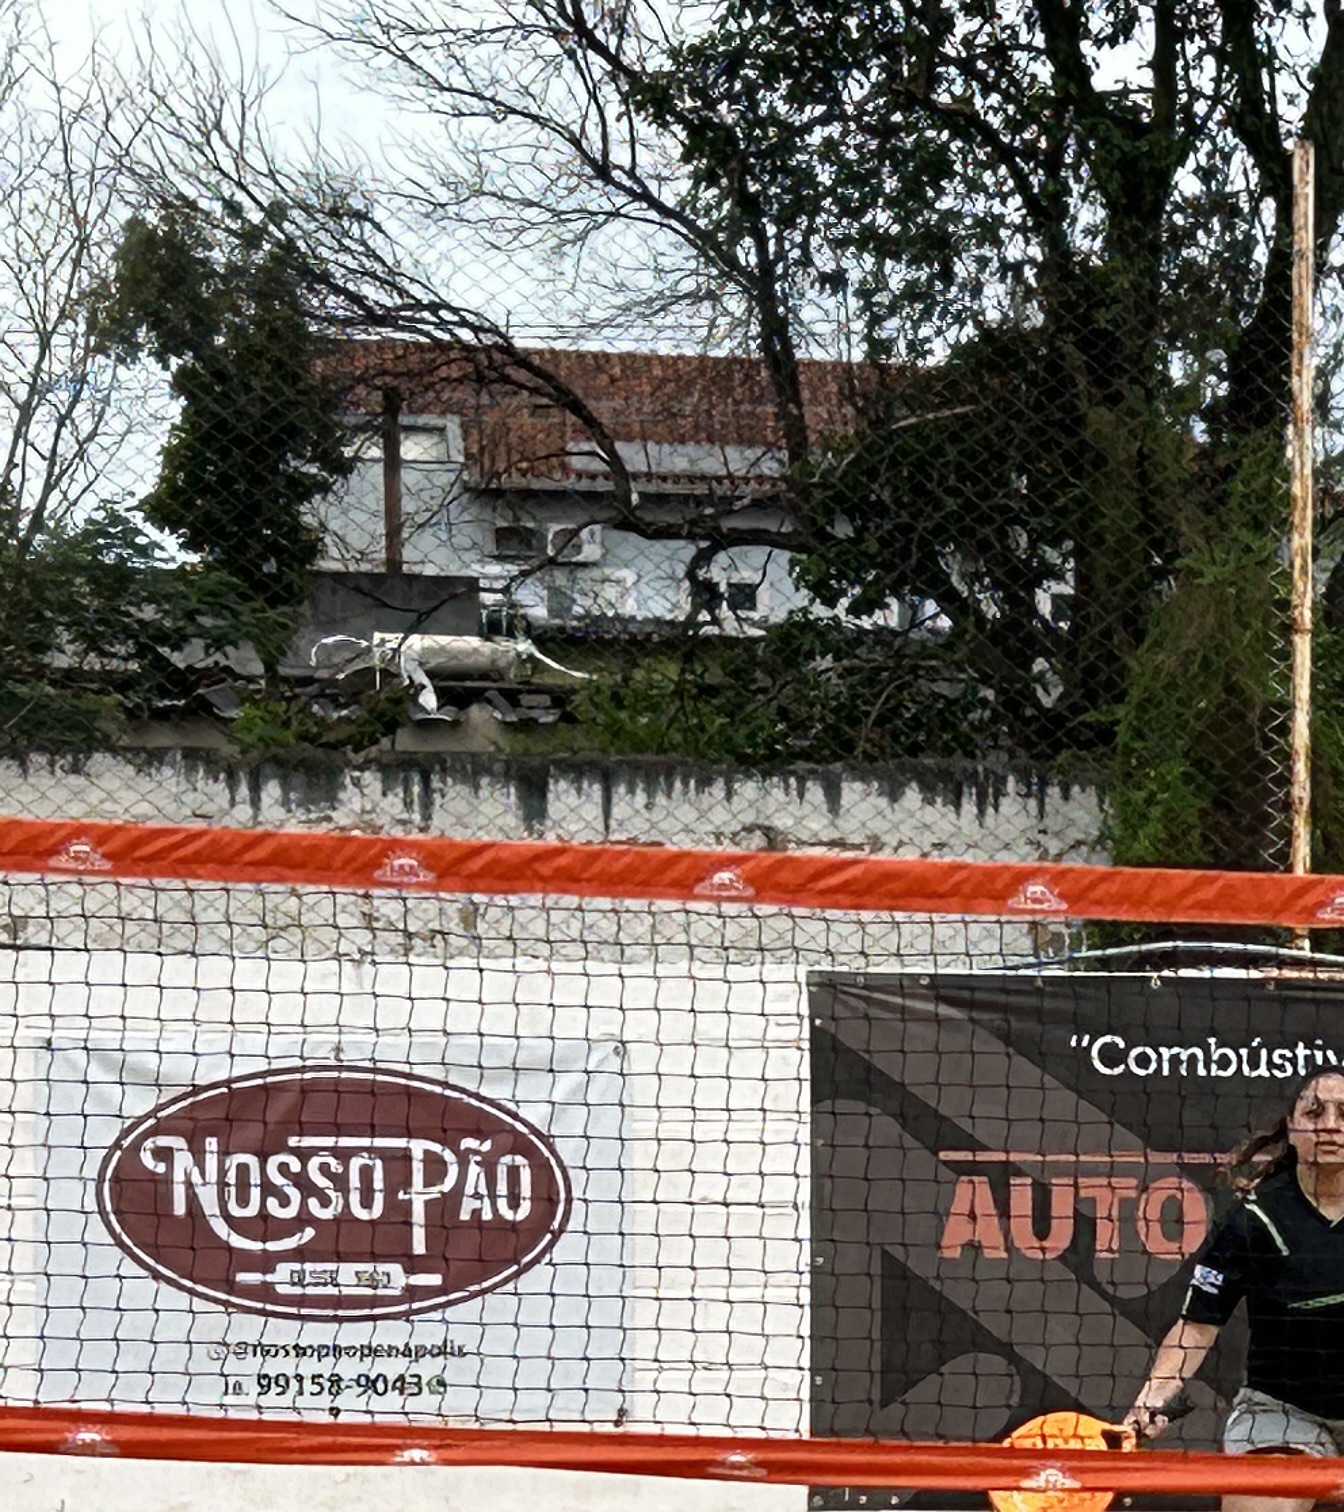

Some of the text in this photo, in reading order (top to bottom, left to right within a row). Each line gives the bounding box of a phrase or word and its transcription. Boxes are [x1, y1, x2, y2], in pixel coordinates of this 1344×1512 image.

[140, 1135, 532, 1255] NOSSO PÃO
[938, 1175, 1214, 1260] AUTO
[256, 1372, 424, 1398] 99158-9043
